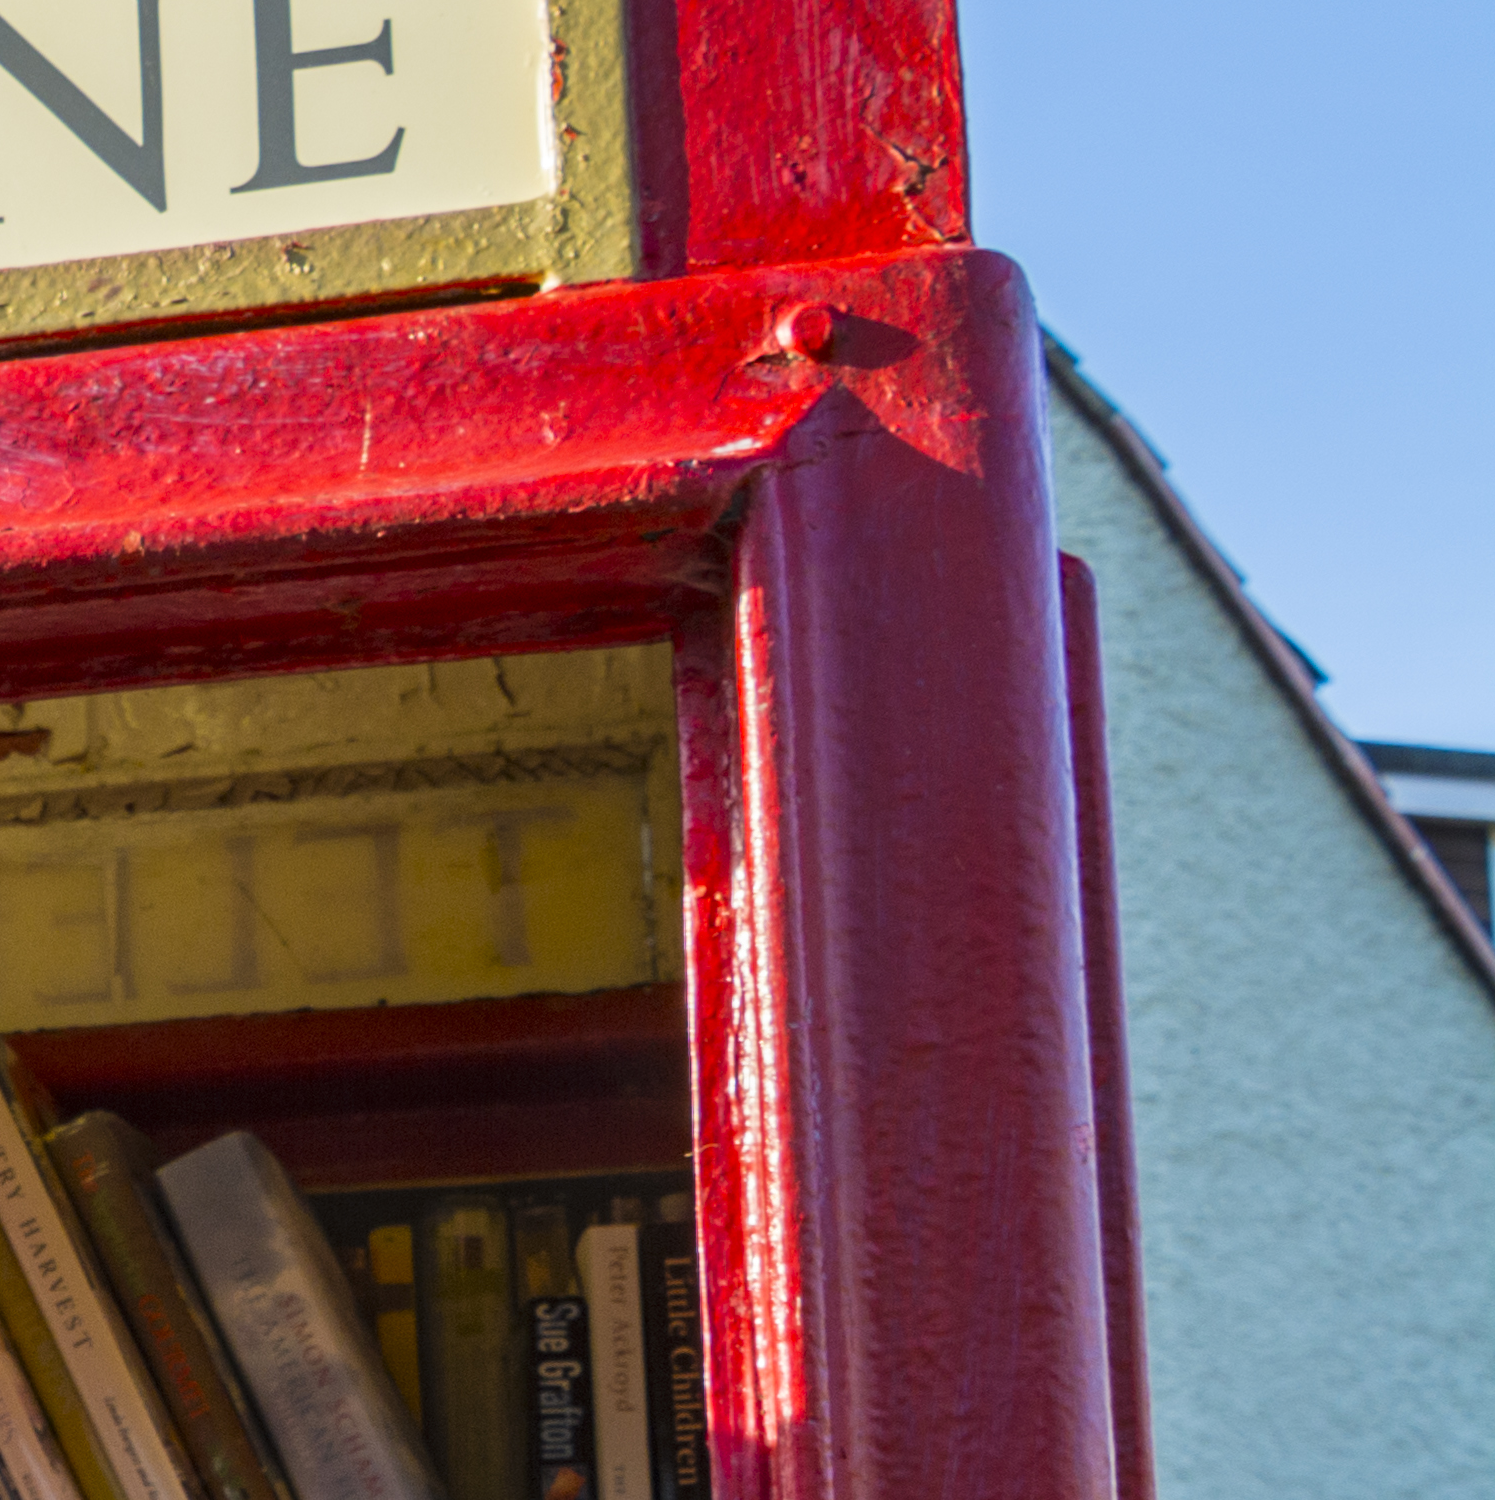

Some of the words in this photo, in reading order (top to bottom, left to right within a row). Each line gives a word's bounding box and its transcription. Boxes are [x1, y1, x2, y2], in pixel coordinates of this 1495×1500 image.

[12, 1214, 101, 1354] HARVEST
[606, 1243, 631, 1304] Peter
[663, 1255, 697, 1336] Little
[535, 1302, 581, 1352] Sue
[607, 1318, 637, 1412] Ackroyd
[538, 1359, 585, 1459] Grafton
[669, 1347, 706, 1485] Children
